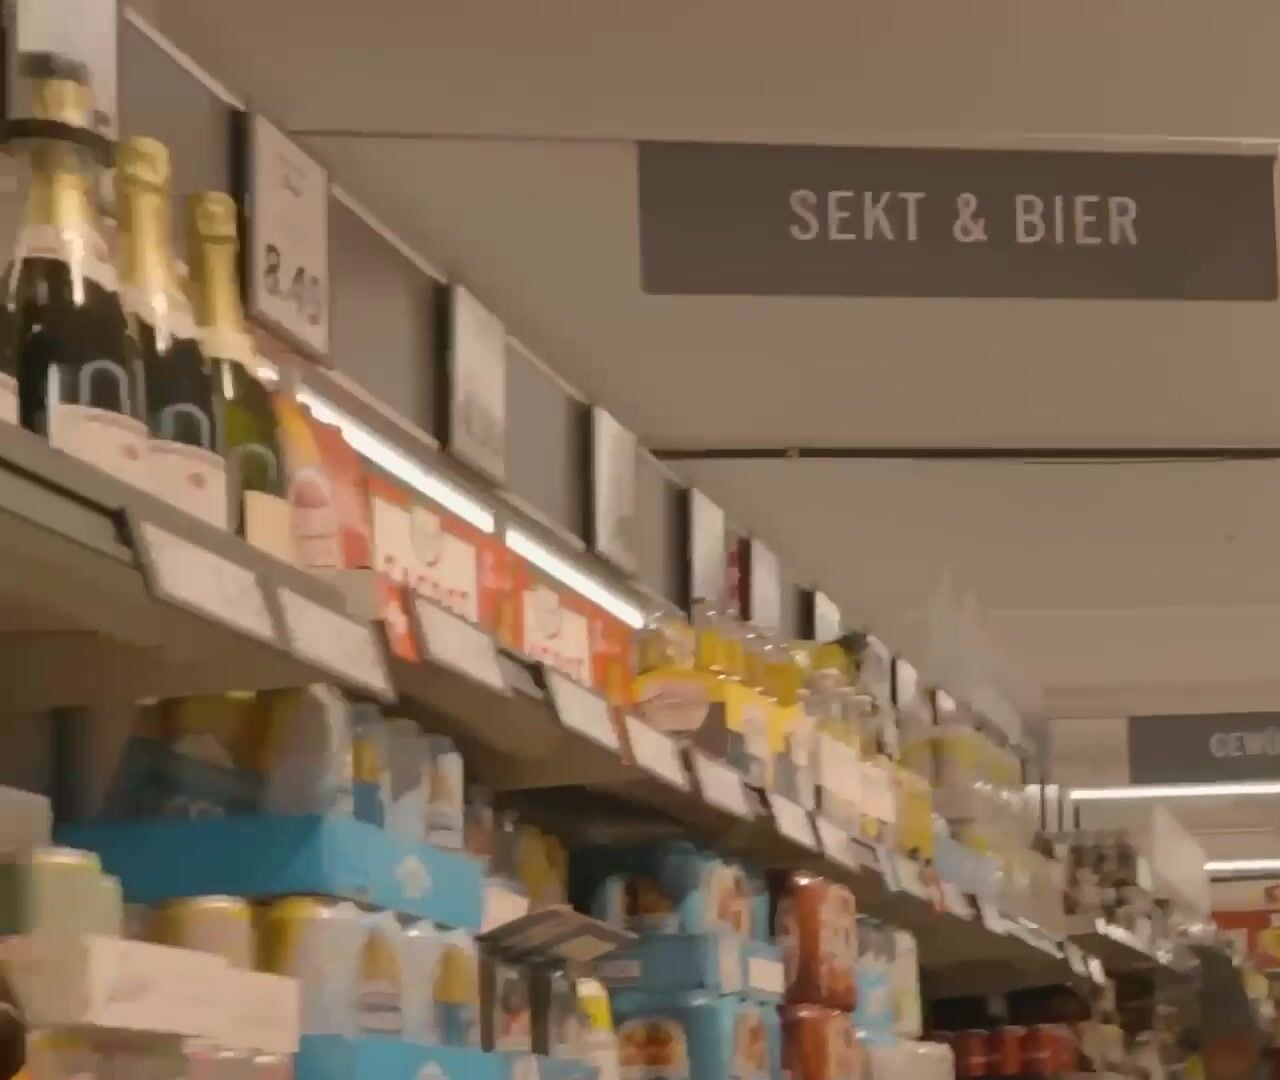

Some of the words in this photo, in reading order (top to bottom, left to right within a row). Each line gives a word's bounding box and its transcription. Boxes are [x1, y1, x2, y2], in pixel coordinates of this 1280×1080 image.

[789, 189, 926, 241] SEKT
[952, 192, 988, 243] &
[1014, 194, 1139, 245] BIER
